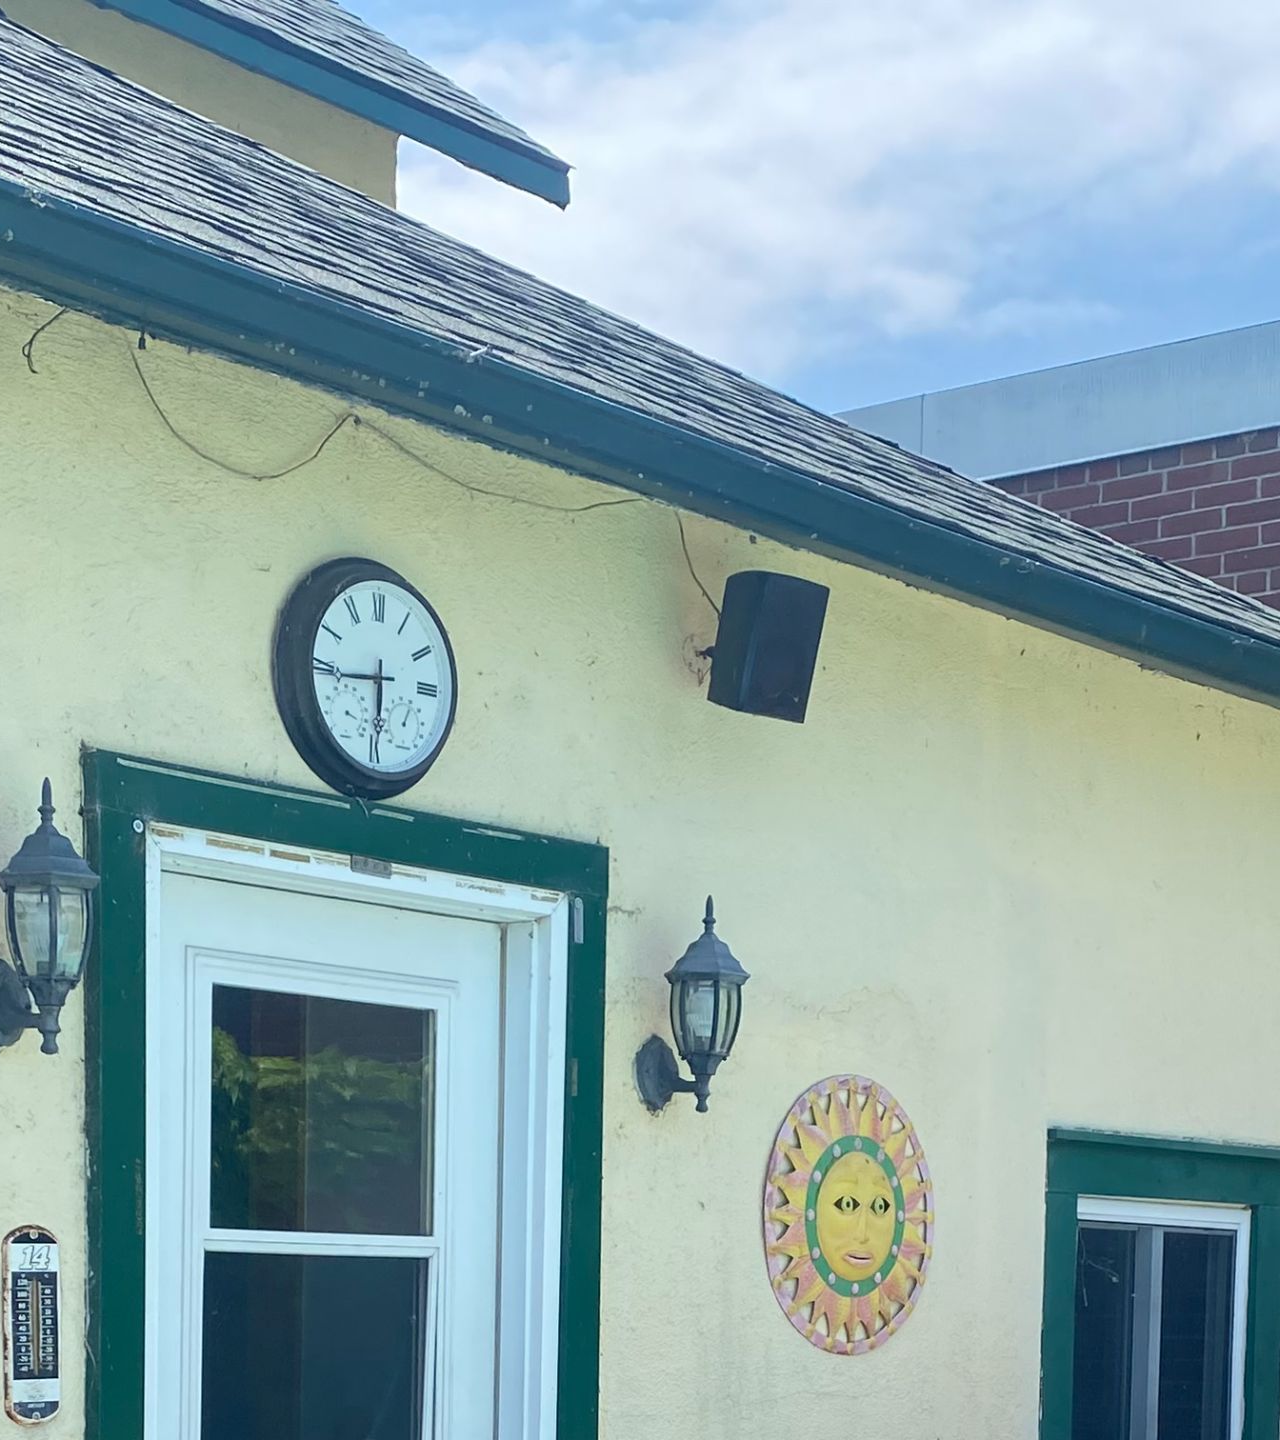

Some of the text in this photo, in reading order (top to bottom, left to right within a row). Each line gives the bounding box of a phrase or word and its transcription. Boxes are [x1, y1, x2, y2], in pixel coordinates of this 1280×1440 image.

[371, 592, 386, 624] XII
[416, 681, 438, 698] III
[19, 1245, 51, 1270] 14
